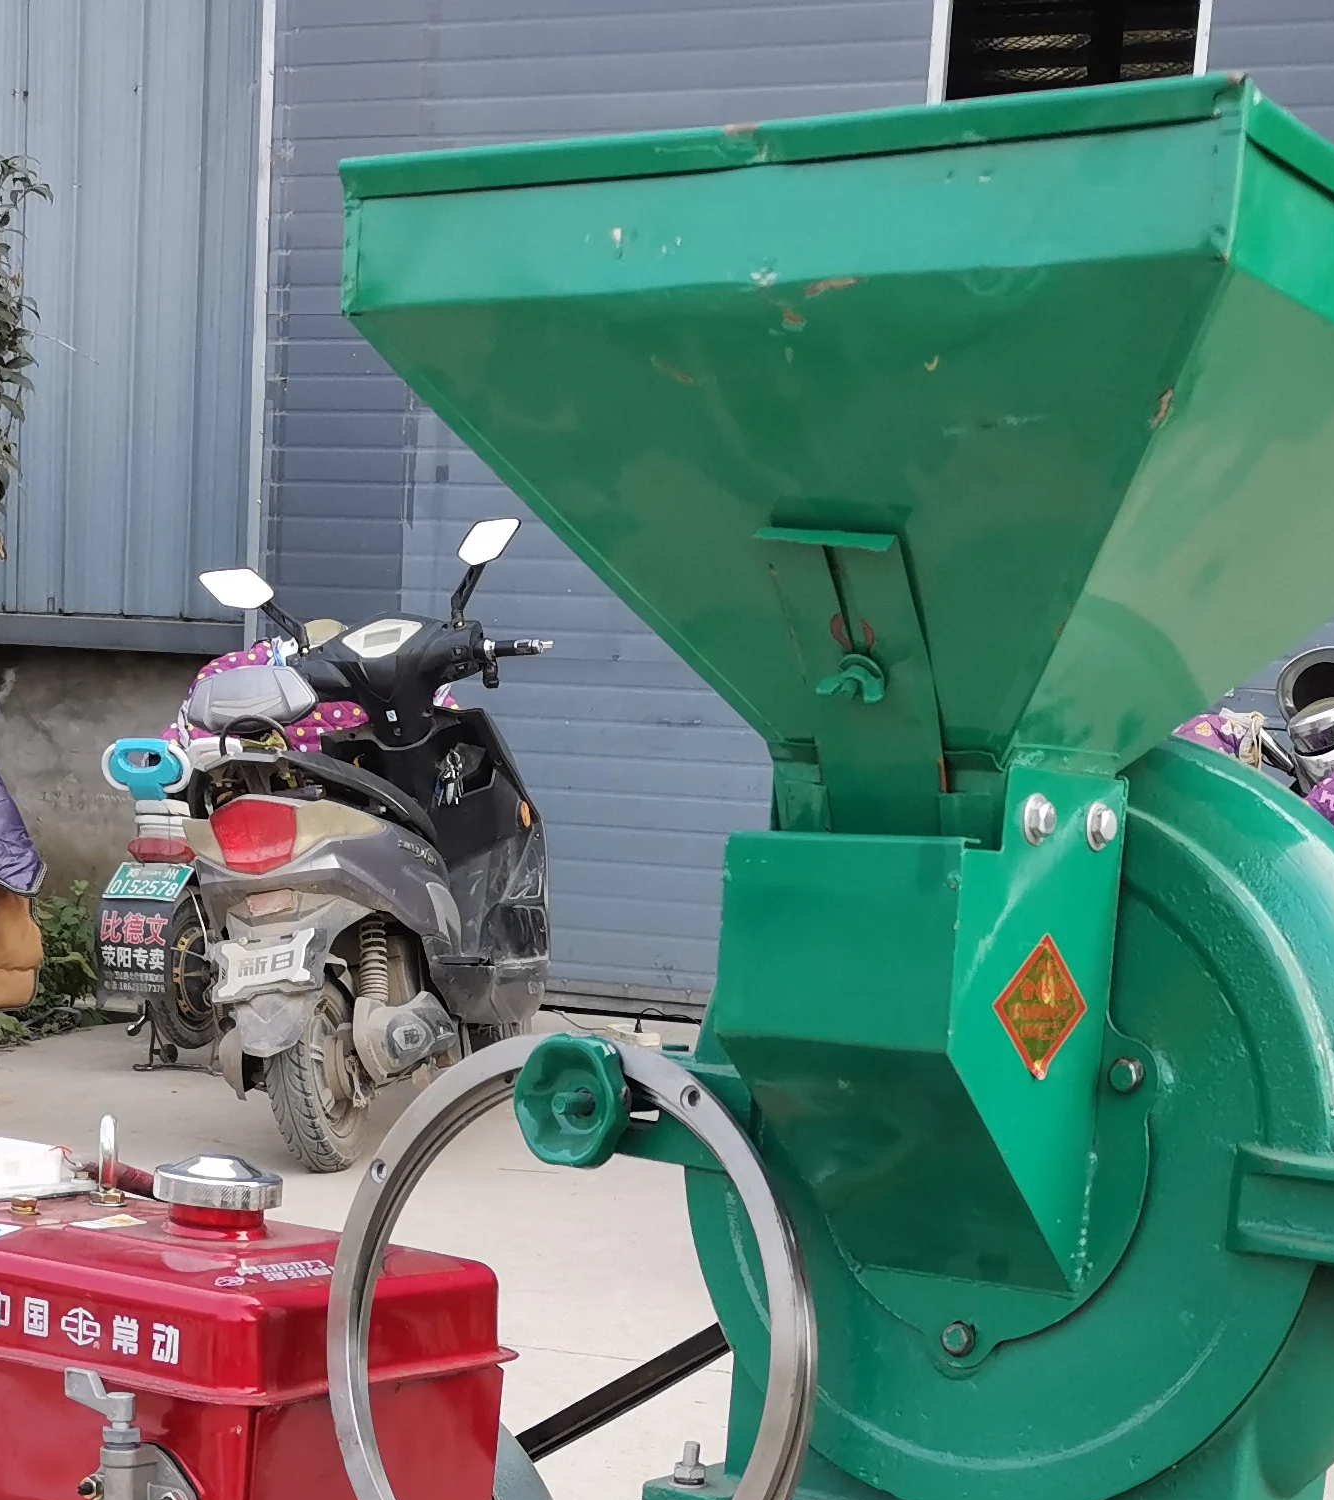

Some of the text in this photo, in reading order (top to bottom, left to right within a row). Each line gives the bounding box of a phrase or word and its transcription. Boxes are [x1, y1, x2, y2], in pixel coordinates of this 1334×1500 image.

[109, 879, 179, 897] 0152578
[100, 909, 168, 947] 比德文
[100, 944, 165, 971] 荥阳专卖
[237, 949, 295, 978] 新日
[112, 1314, 180, 1365] 常动
